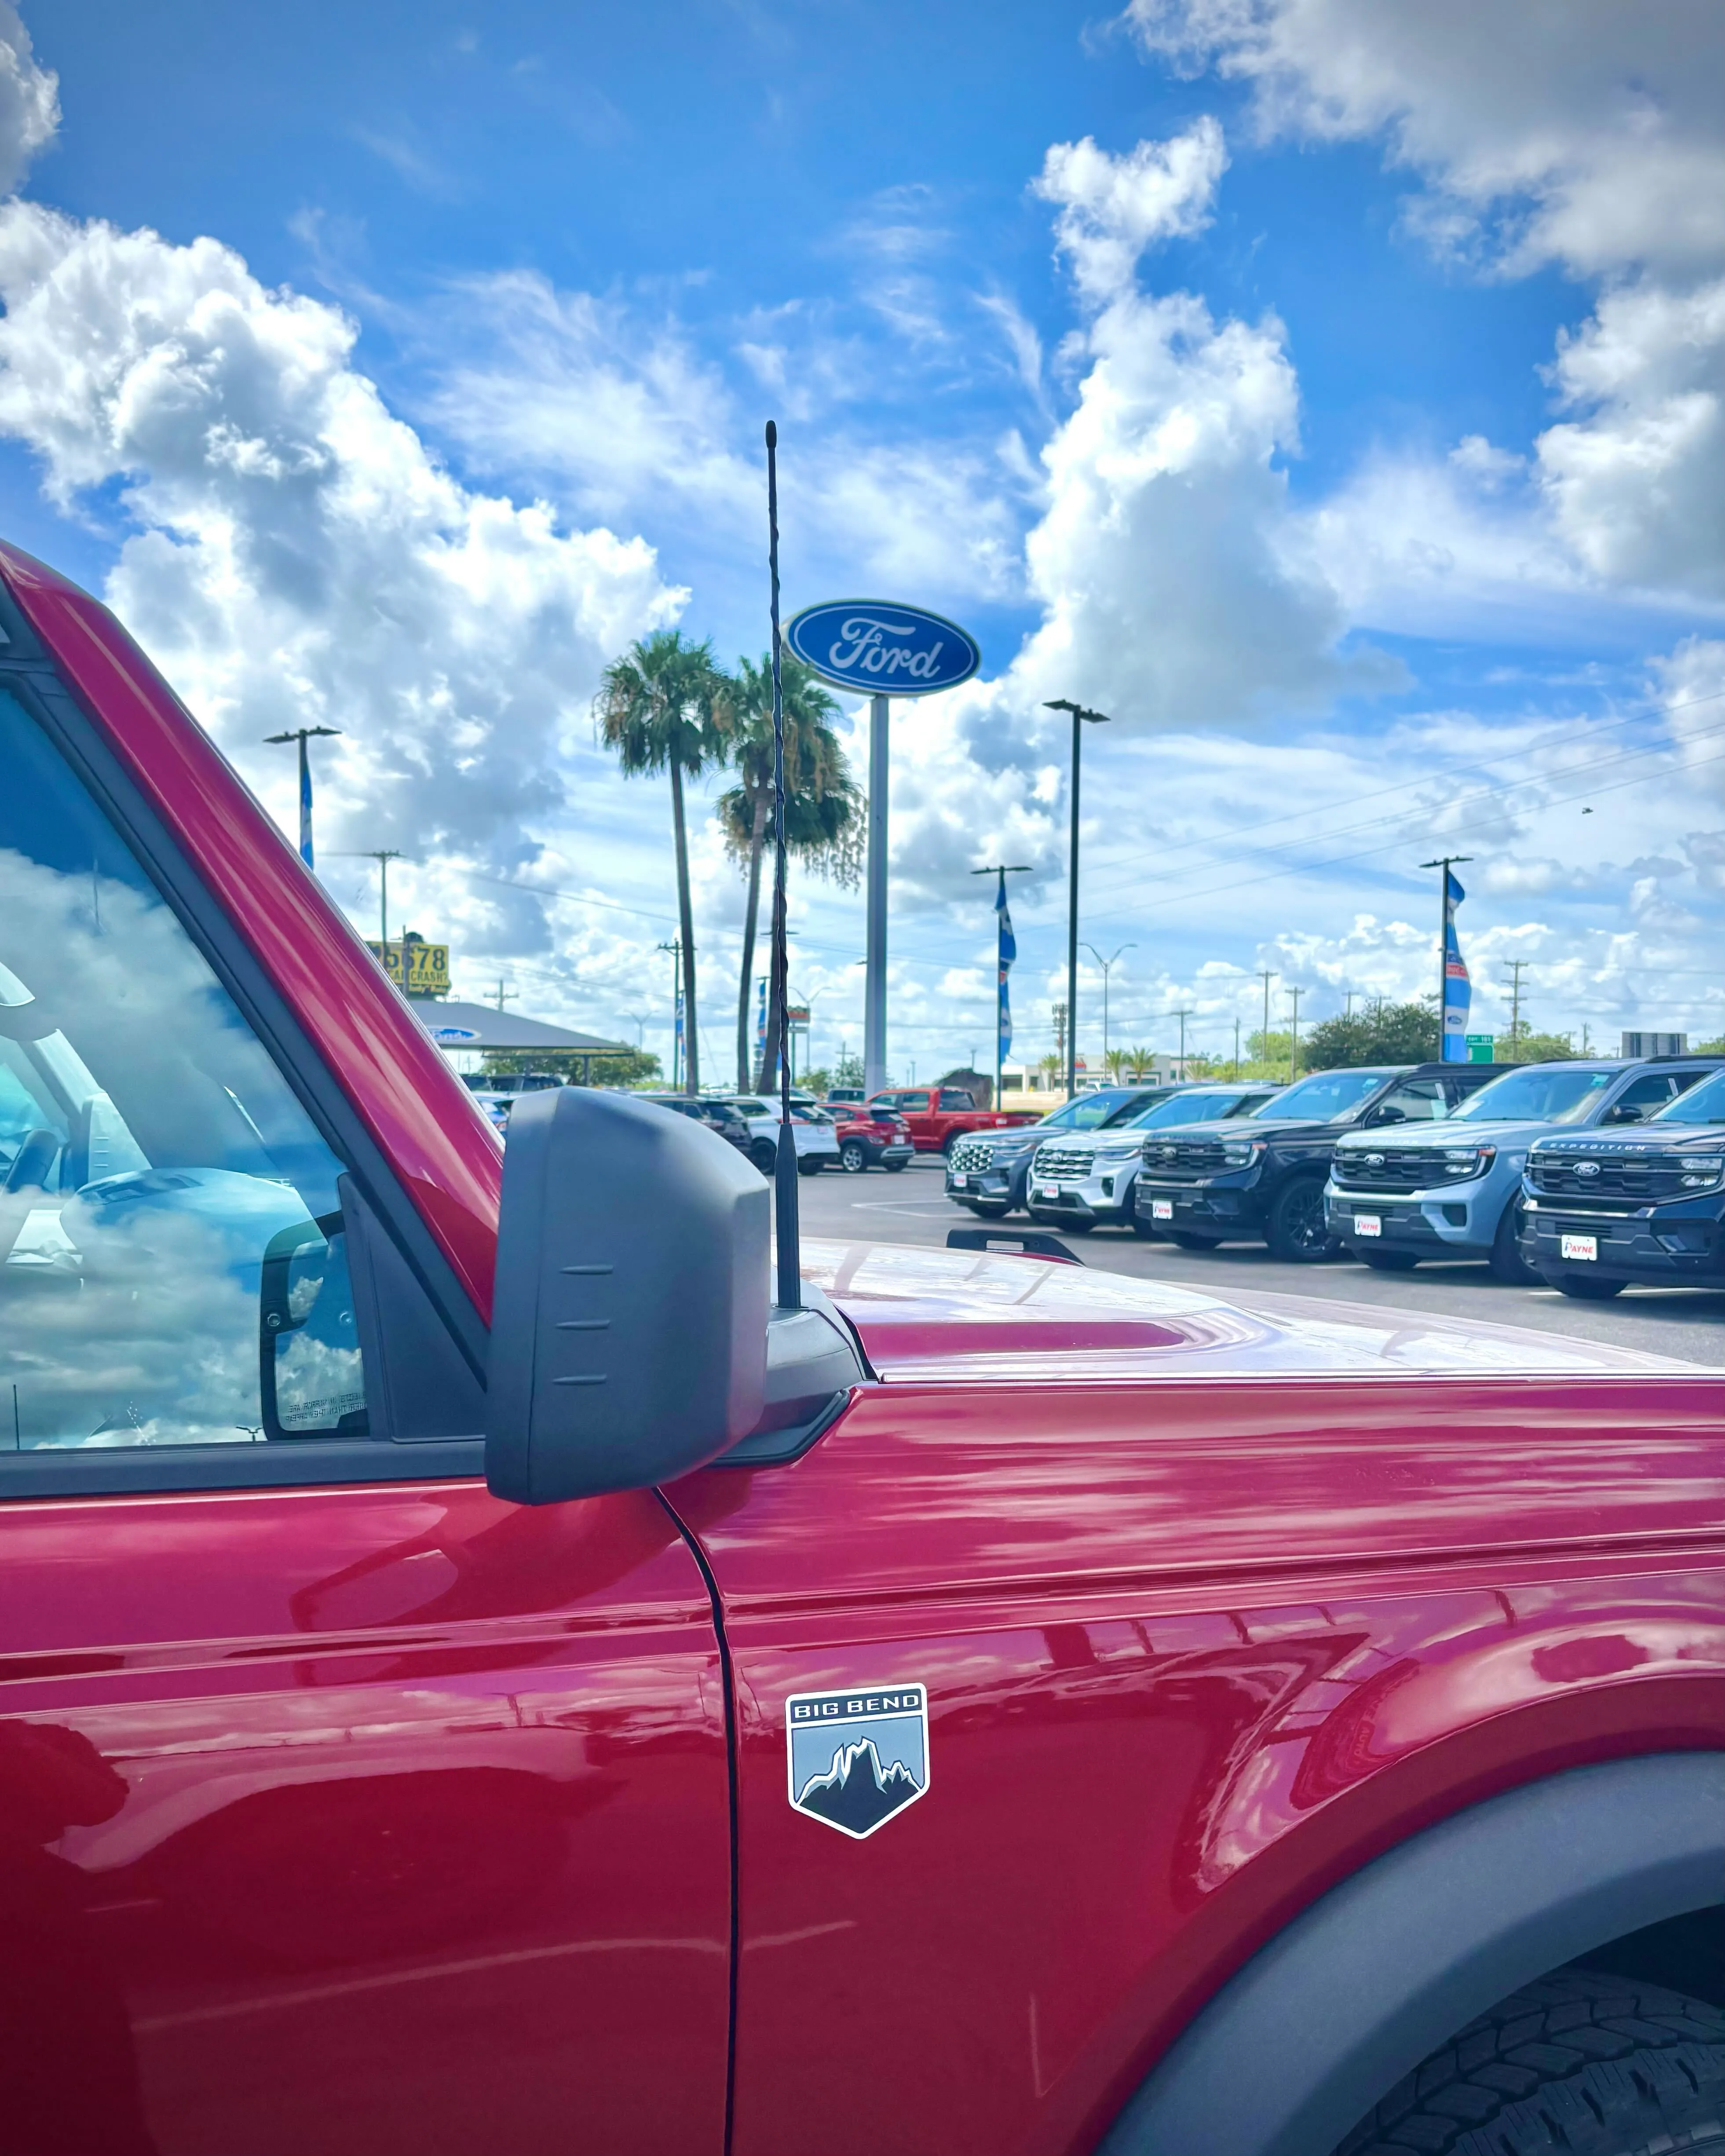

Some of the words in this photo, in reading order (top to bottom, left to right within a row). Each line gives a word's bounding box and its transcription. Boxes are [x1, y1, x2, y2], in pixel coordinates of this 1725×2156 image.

[829, 617, 944, 678] Ford
[1550, 1143, 1646, 1151] EXPEDITION
[1565, 1242, 1593, 1253] PAYNE
[794, 1703, 838, 1718] BIG
[847, 1695, 919, 1713] BEND
